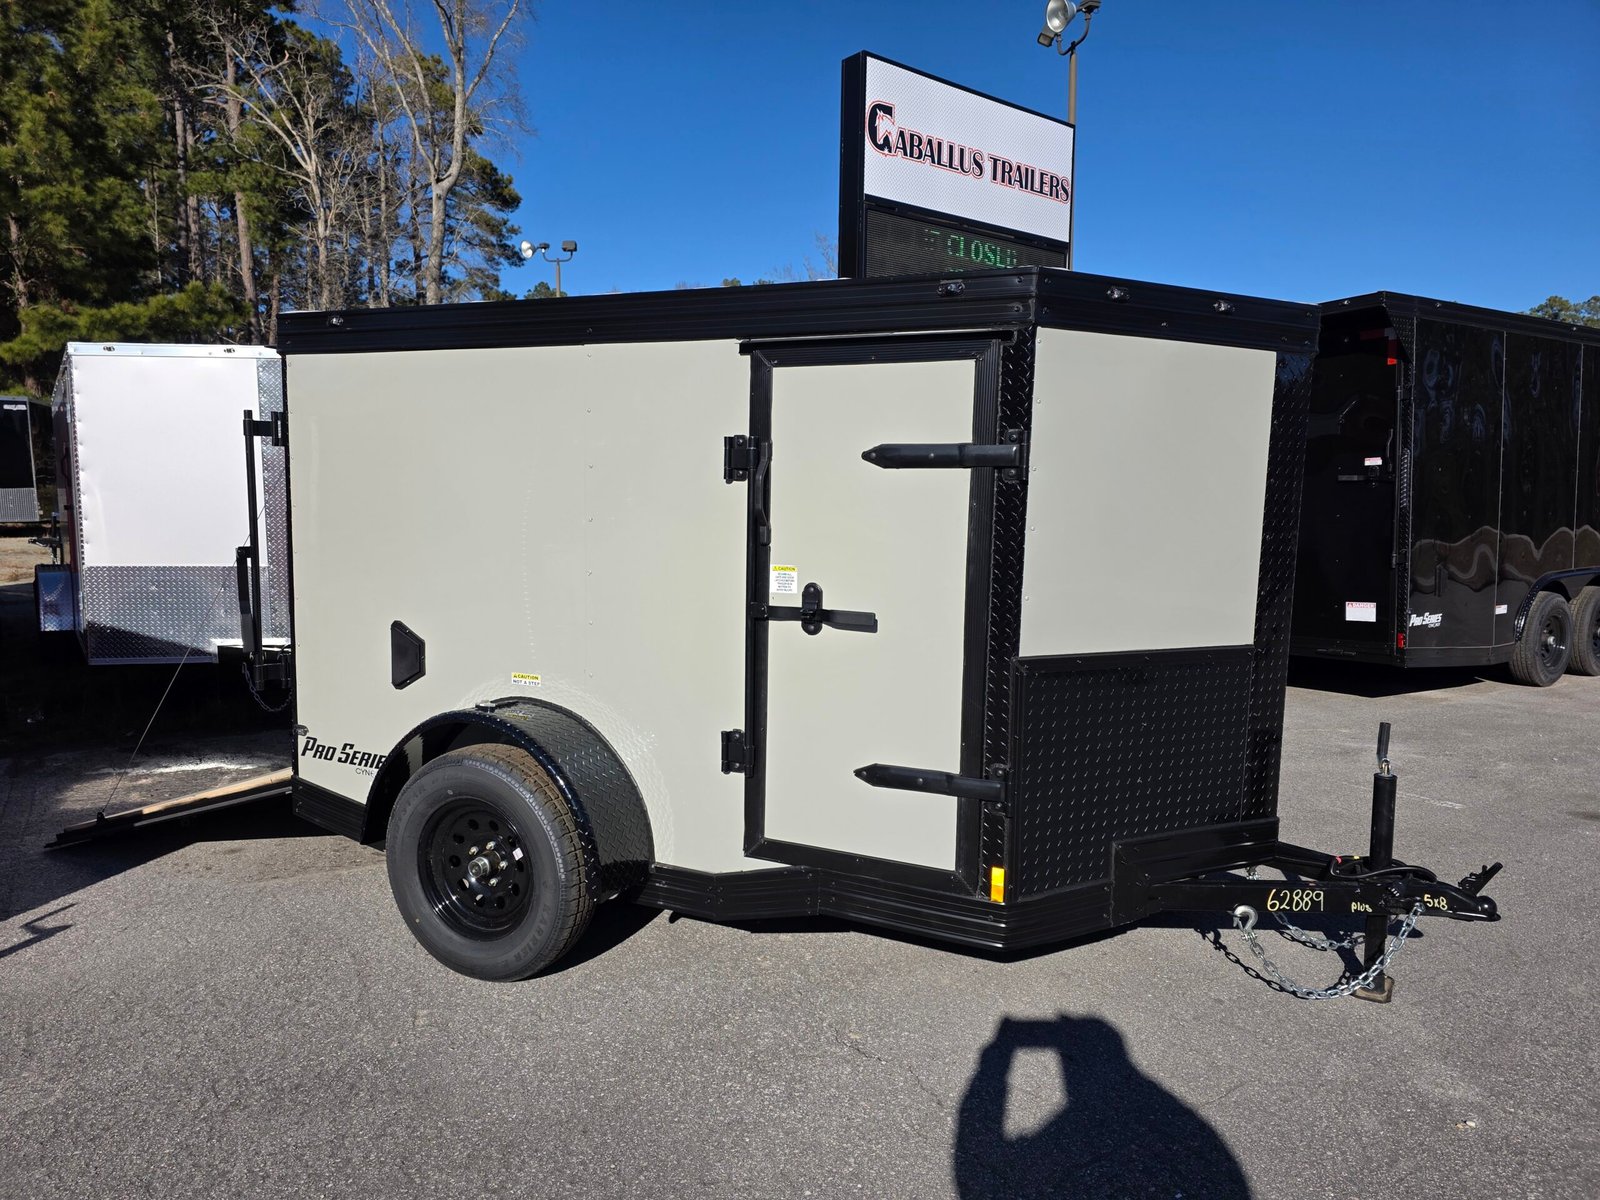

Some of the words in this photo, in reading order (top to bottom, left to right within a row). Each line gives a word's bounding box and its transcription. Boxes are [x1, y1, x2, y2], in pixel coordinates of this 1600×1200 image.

[867, 101, 984, 178] CABALLUS
[988, 153, 1070, 203] TRAILERS
[337, 742, 388, 769] SERIE
[1267, 888, 1324, 912] 62889
[1423, 894, 1448, 911] 5x8
